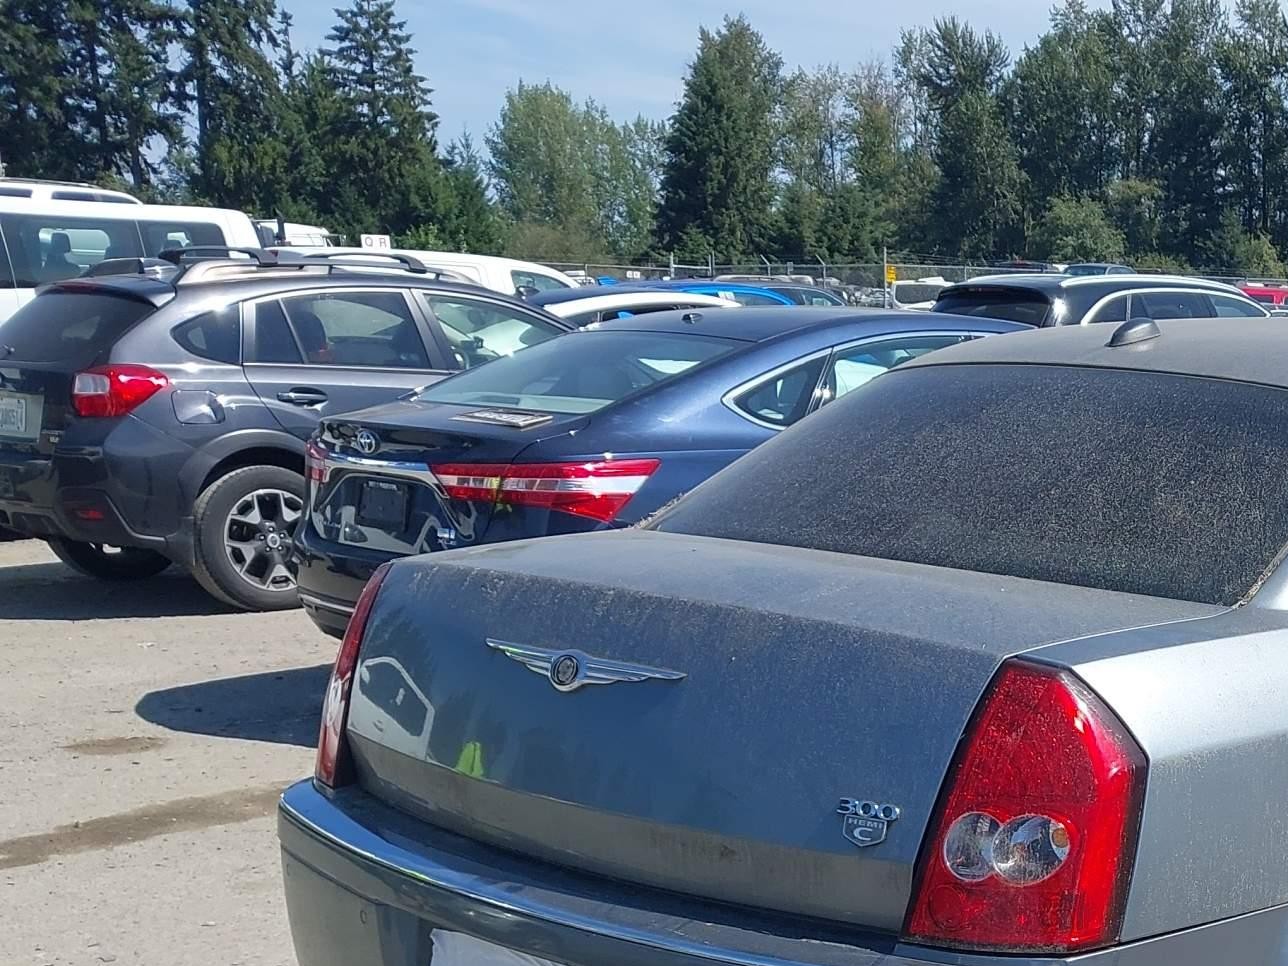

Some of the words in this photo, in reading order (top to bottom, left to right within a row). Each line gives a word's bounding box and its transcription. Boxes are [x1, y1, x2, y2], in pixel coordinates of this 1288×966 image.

[379, 237, 387, 248] R
[836, 797, 901, 821] 300
[848, 817, 884, 829] HEMI
[853, 827, 873, 841] C
